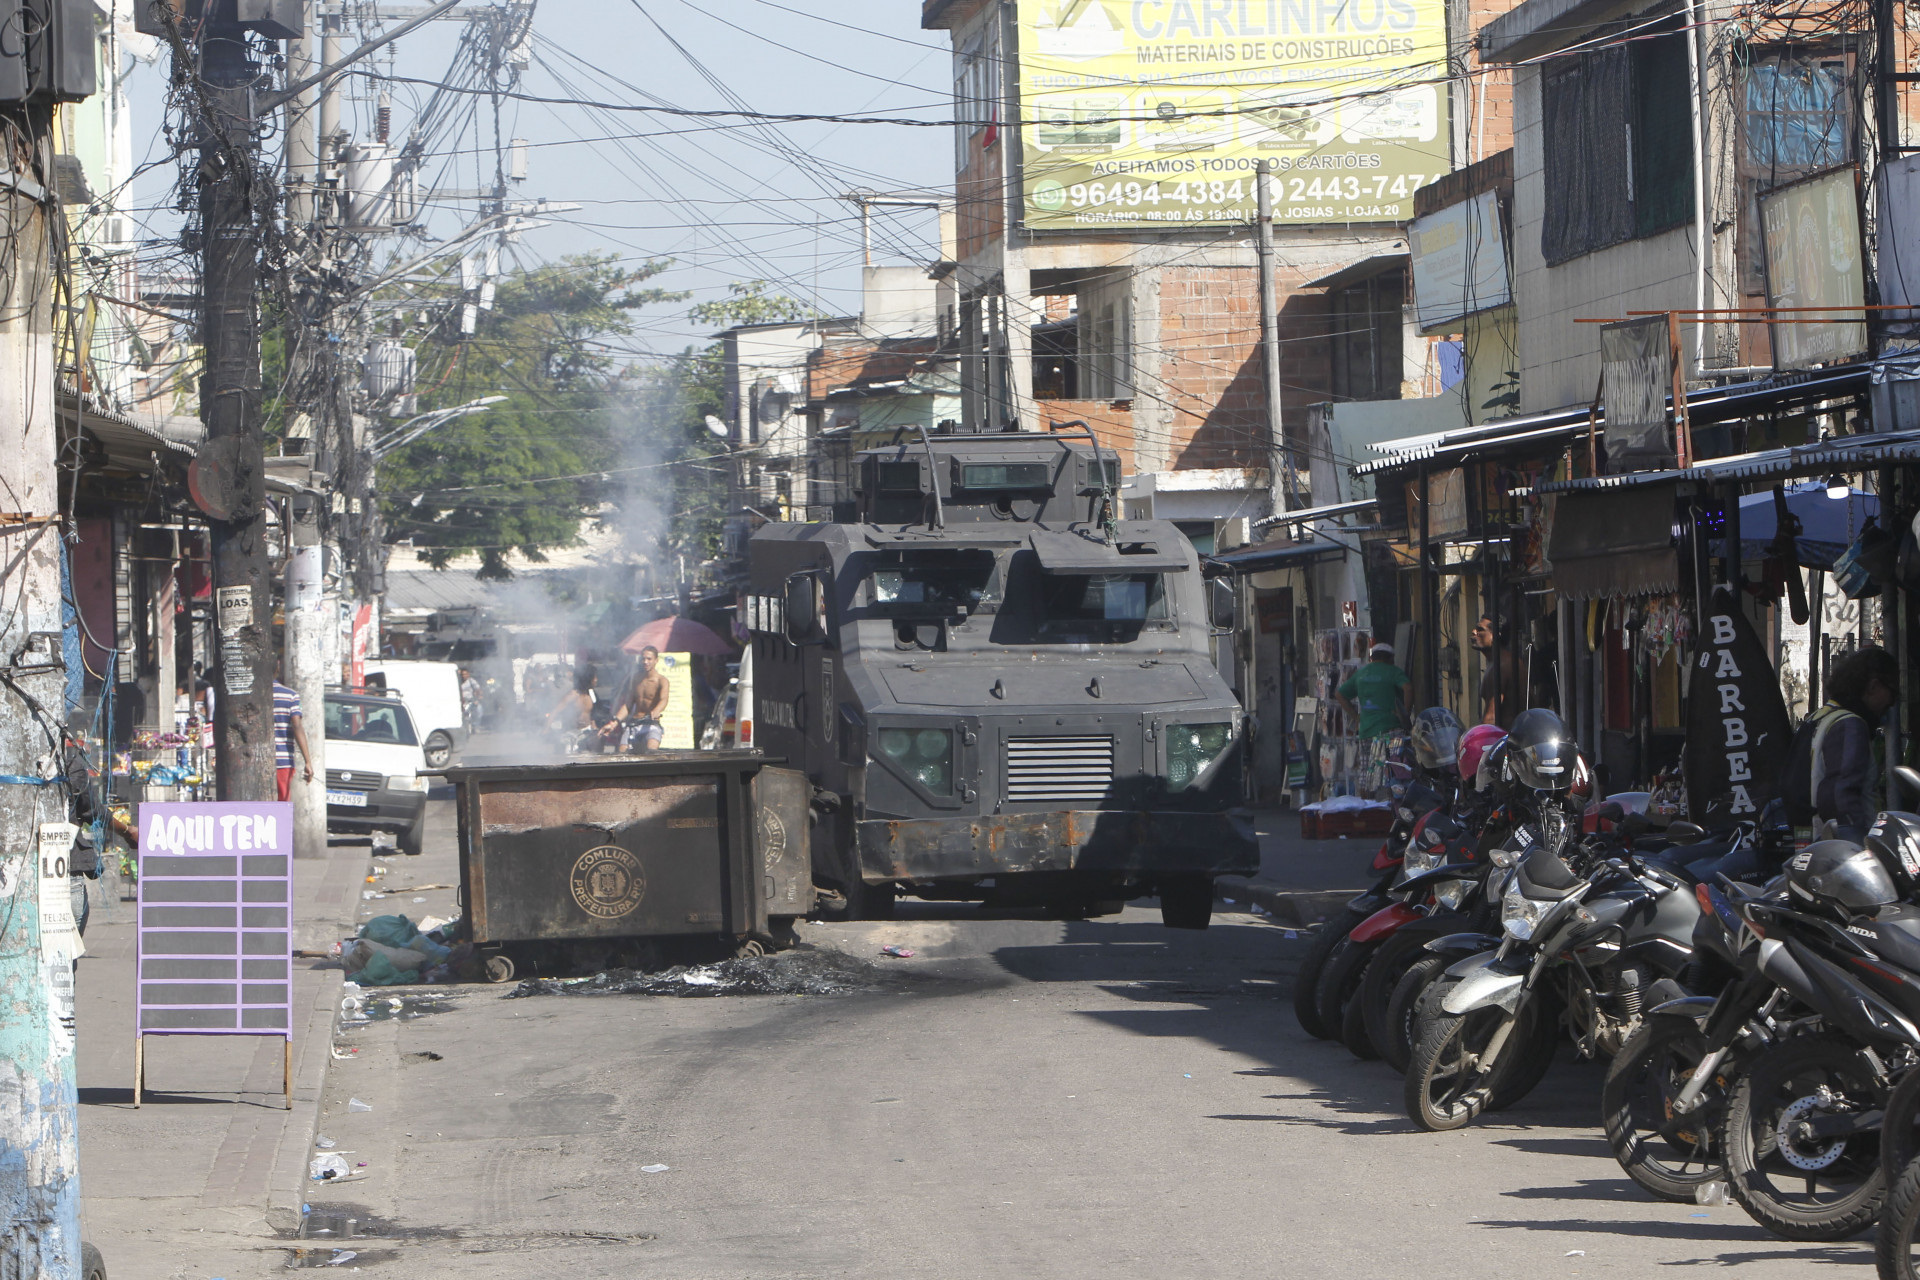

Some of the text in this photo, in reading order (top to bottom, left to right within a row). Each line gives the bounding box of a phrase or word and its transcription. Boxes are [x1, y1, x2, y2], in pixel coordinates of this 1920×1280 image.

[1131, 0, 1416, 39] CARLINHOS
[1137, 35, 1414, 64] MATERIAIS DE CONSTRUÇÕES
[1031, 75, 1081, 89] TUDO
[1085, 73, 1131, 87] PARA
[1136, 72, 1171, 87] SUA
[1177, 71, 1230, 86] OBRA
[1233, 66, 1285, 84] VOCÊ
[1288, 66, 1384, 83] ENCONTRA
[1092, 152, 1381, 174] ACEITAMOS TODOS OS CARTÕES
[1070, 179, 1245, 207] 96494-4384
[1075, 209, 1143, 223] HORÁRIO:
[1146, 210, 1181, 221] 08:00
[1207, 209, 1242, 220] 19:00
[1284, 205, 1334, 218] JOSIAS
[1346, 204, 1381, 216] LOJA
[1384, 204, 1400, 216] 20
[220, 598, 249, 609] LOAS
[147, 813, 278, 856] AQUI TEM
[579, 848, 637, 872] COMLURB
[573, 877, 643, 916] PREFEITURA RIO
